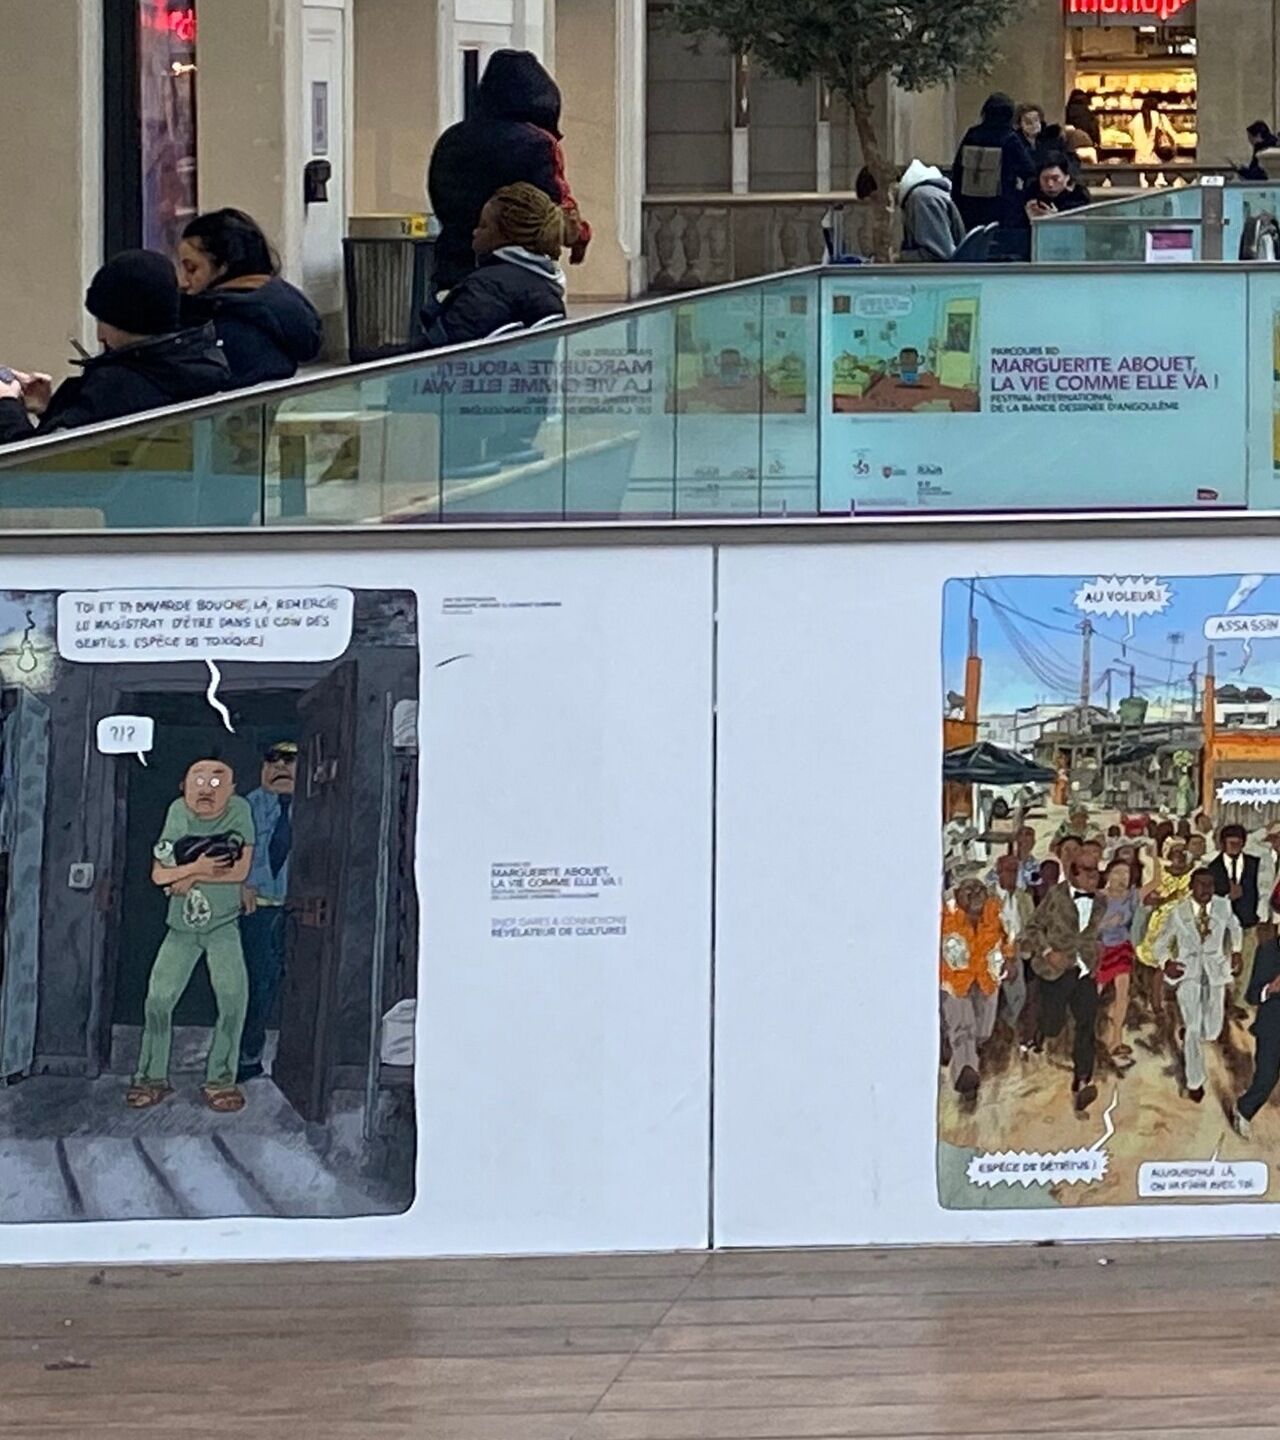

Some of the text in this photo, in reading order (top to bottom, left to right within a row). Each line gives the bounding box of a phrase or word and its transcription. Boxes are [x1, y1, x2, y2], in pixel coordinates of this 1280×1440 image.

[991, 356, 1198, 373] MARGUERITE ABOUET,
[991, 376, 1014, 392] LA
[1020, 376, 1049, 391] VIE
[1055, 375, 1128, 391] COMME
[1136, 374, 1178, 390] ELLE
[1183, 373, 1208, 389] VA
[1085, 592, 1101, 603] AU
